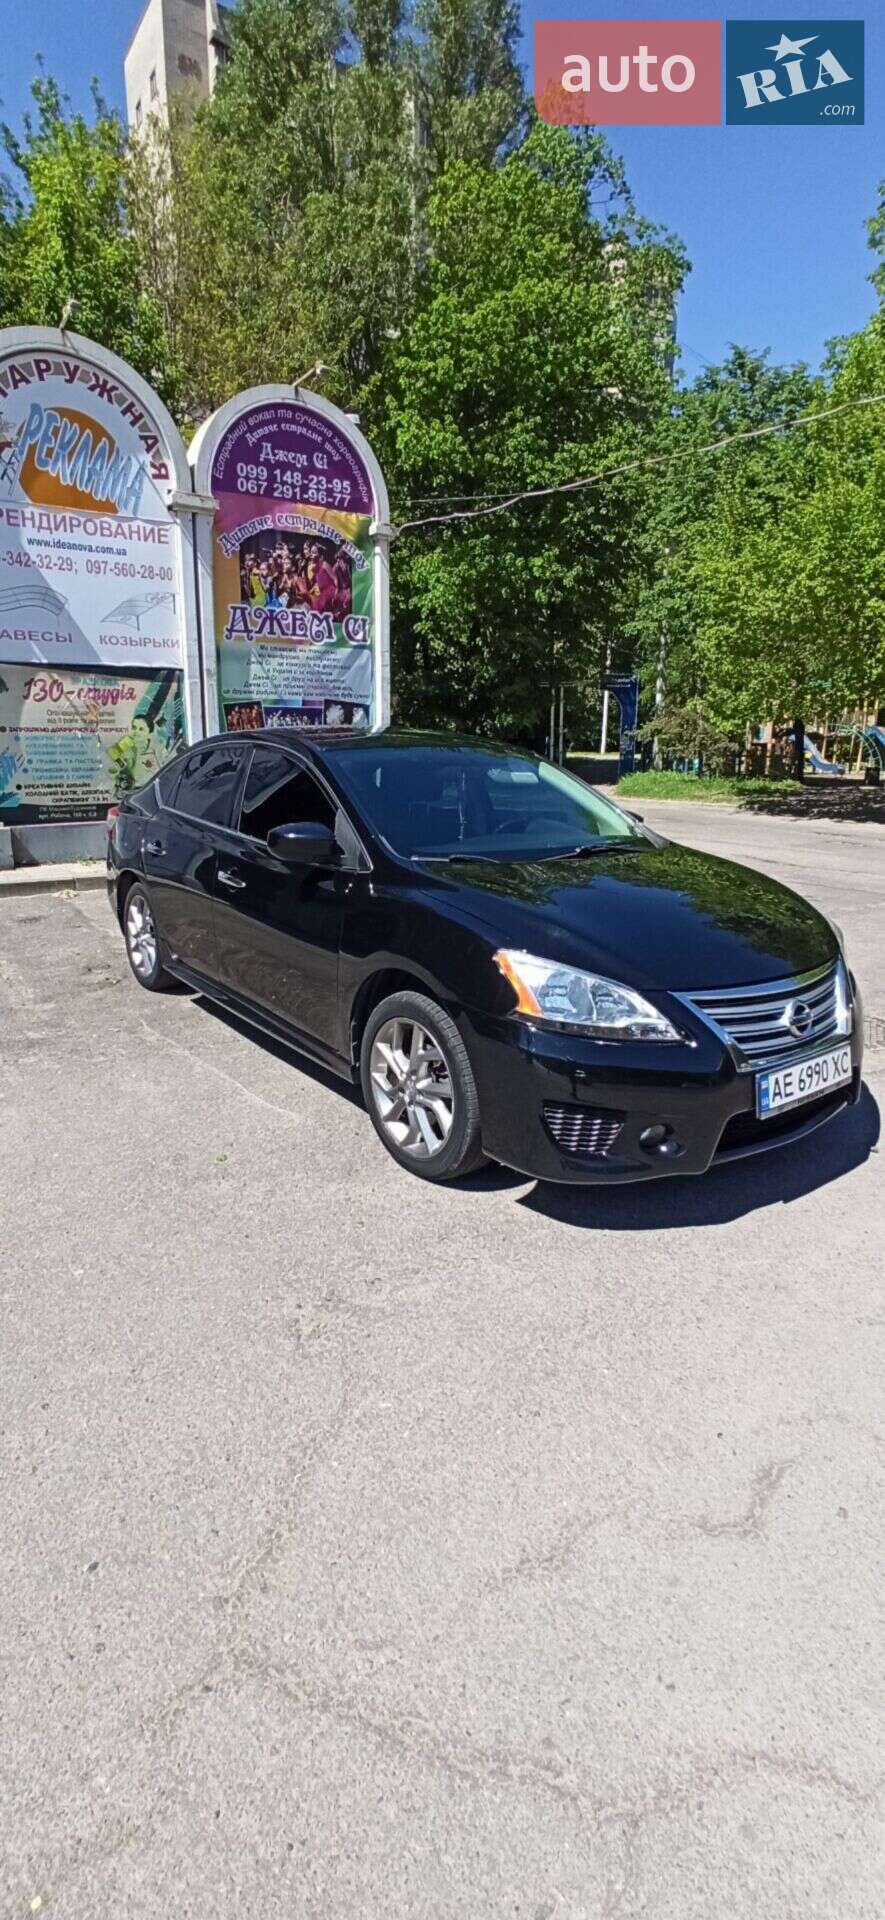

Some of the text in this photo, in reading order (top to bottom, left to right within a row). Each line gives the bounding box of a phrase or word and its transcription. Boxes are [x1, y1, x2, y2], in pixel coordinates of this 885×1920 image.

[17, 402, 147, 516] РЕКЛАМА
[259, 442, 308, 468] Джем
[236, 462, 351, 494] 099 148-23-95
[237, 478, 351, 508] 067 291-96-77
[0, 508, 170, 545] ЕНДИРОВАНИЕ
[27, 536, 127, 556] www.ideanova.com.ua
[0, 550, 173, 582] -342-32-29; 097-560-28-00
[225, 604, 336, 645] ДЖЕМ
[100, 635, 179, 649] КОЗЫРЬКИ
[772, 1072, 794, 1103] AE
[798, 1060, 829, 1092] 6990
[832, 1051, 849, 1080] XC
